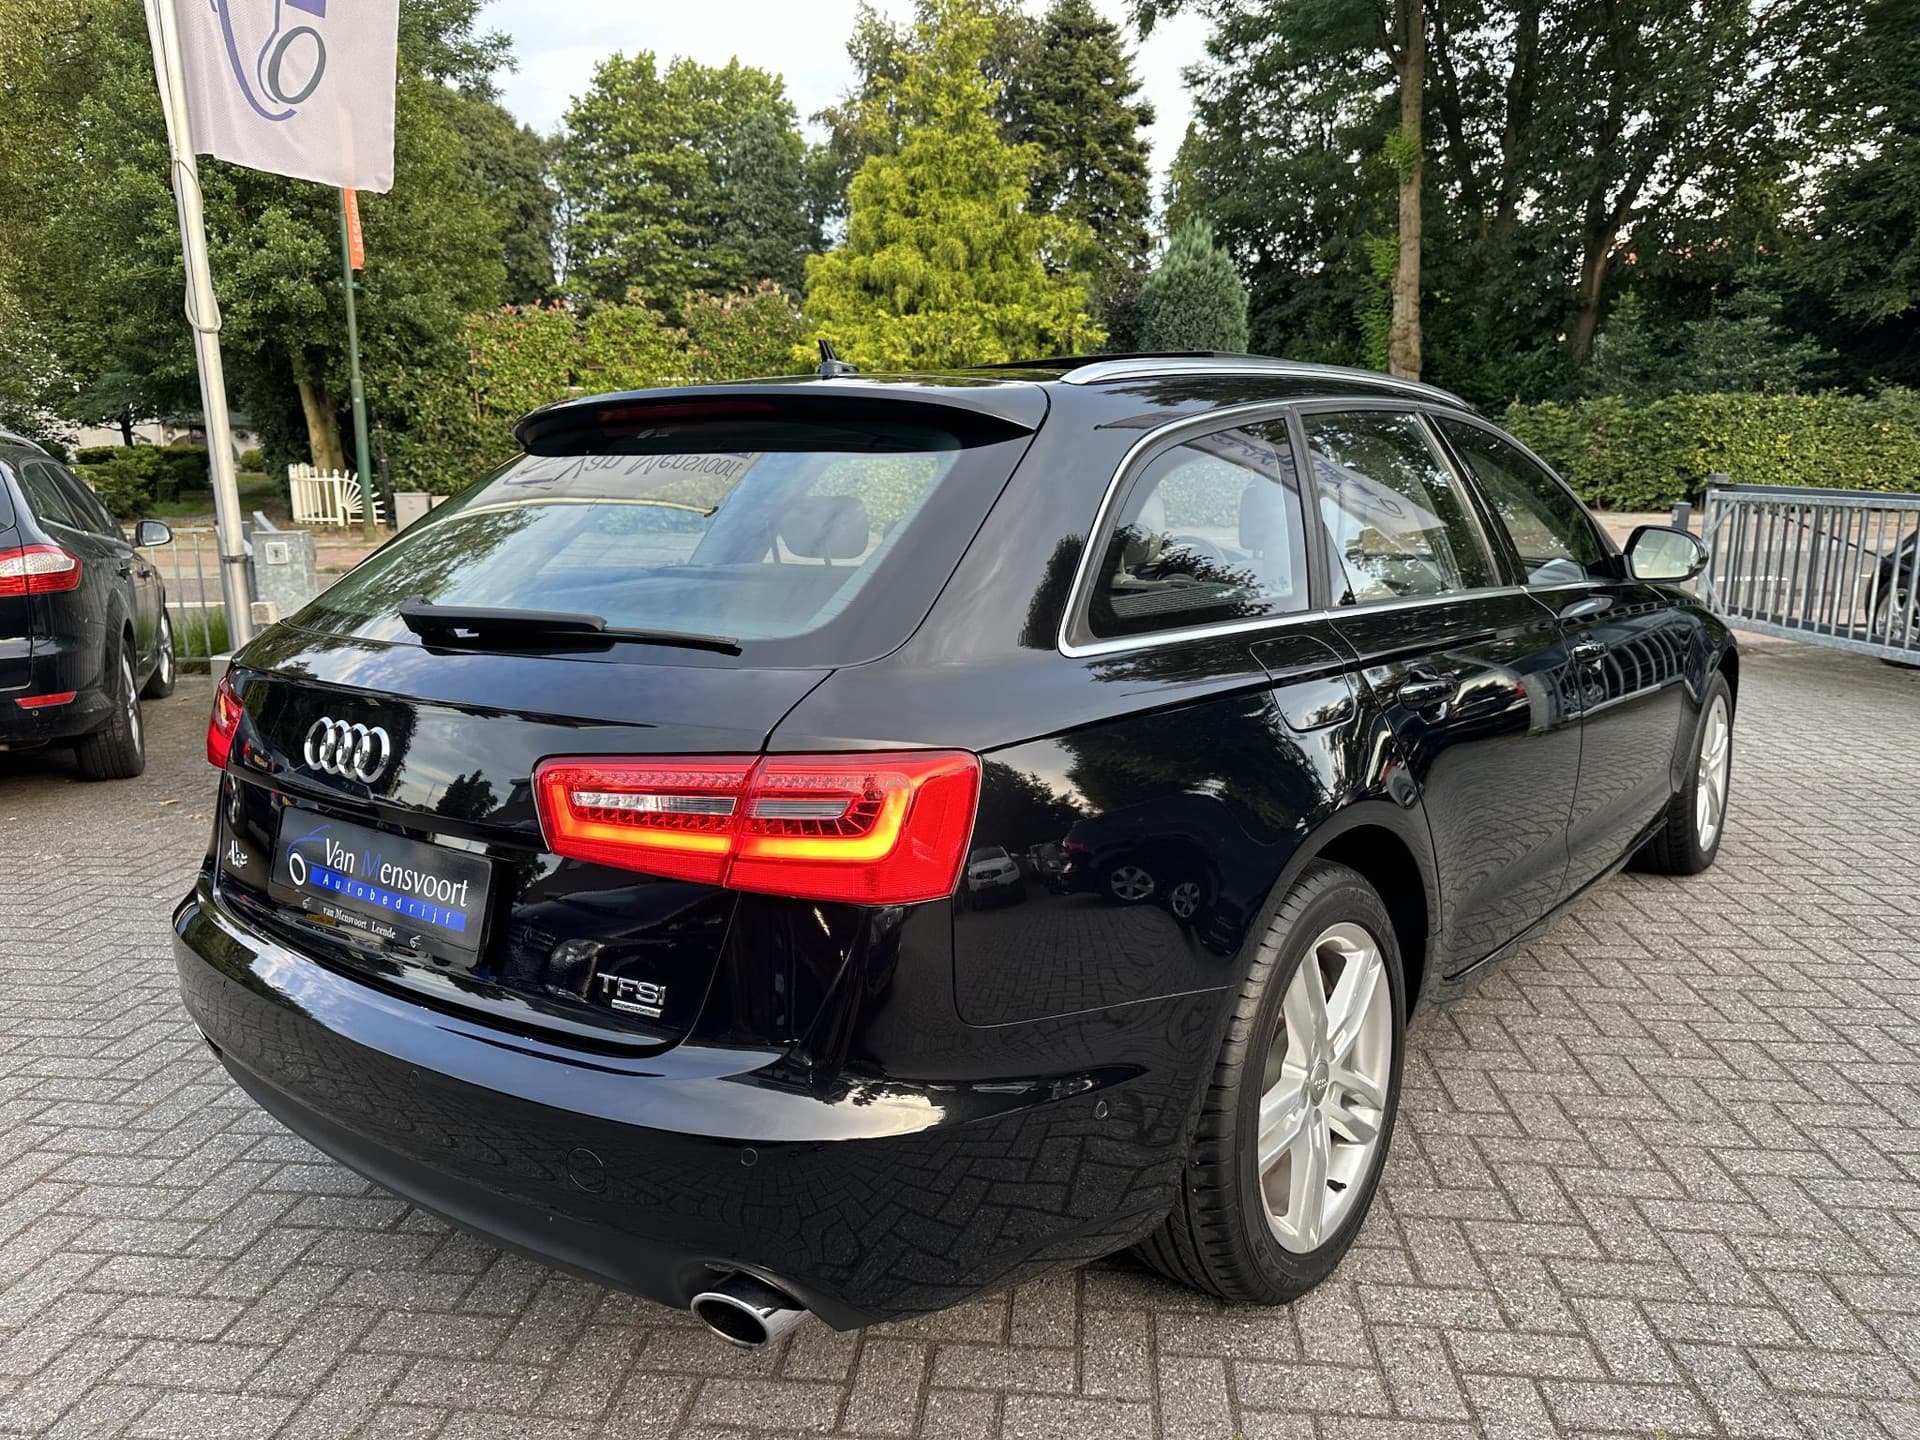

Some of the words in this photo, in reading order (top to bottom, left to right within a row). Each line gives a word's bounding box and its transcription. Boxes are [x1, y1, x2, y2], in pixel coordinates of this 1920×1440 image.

[325, 837, 355, 874] Van
[361, 850, 469, 907] Mensvoort
[322, 873, 452, 925] Autobedrijf
[323, 906, 335, 918] van
[335, 908, 367, 929] Mensvoort
[371, 921, 396, 939] Leende
